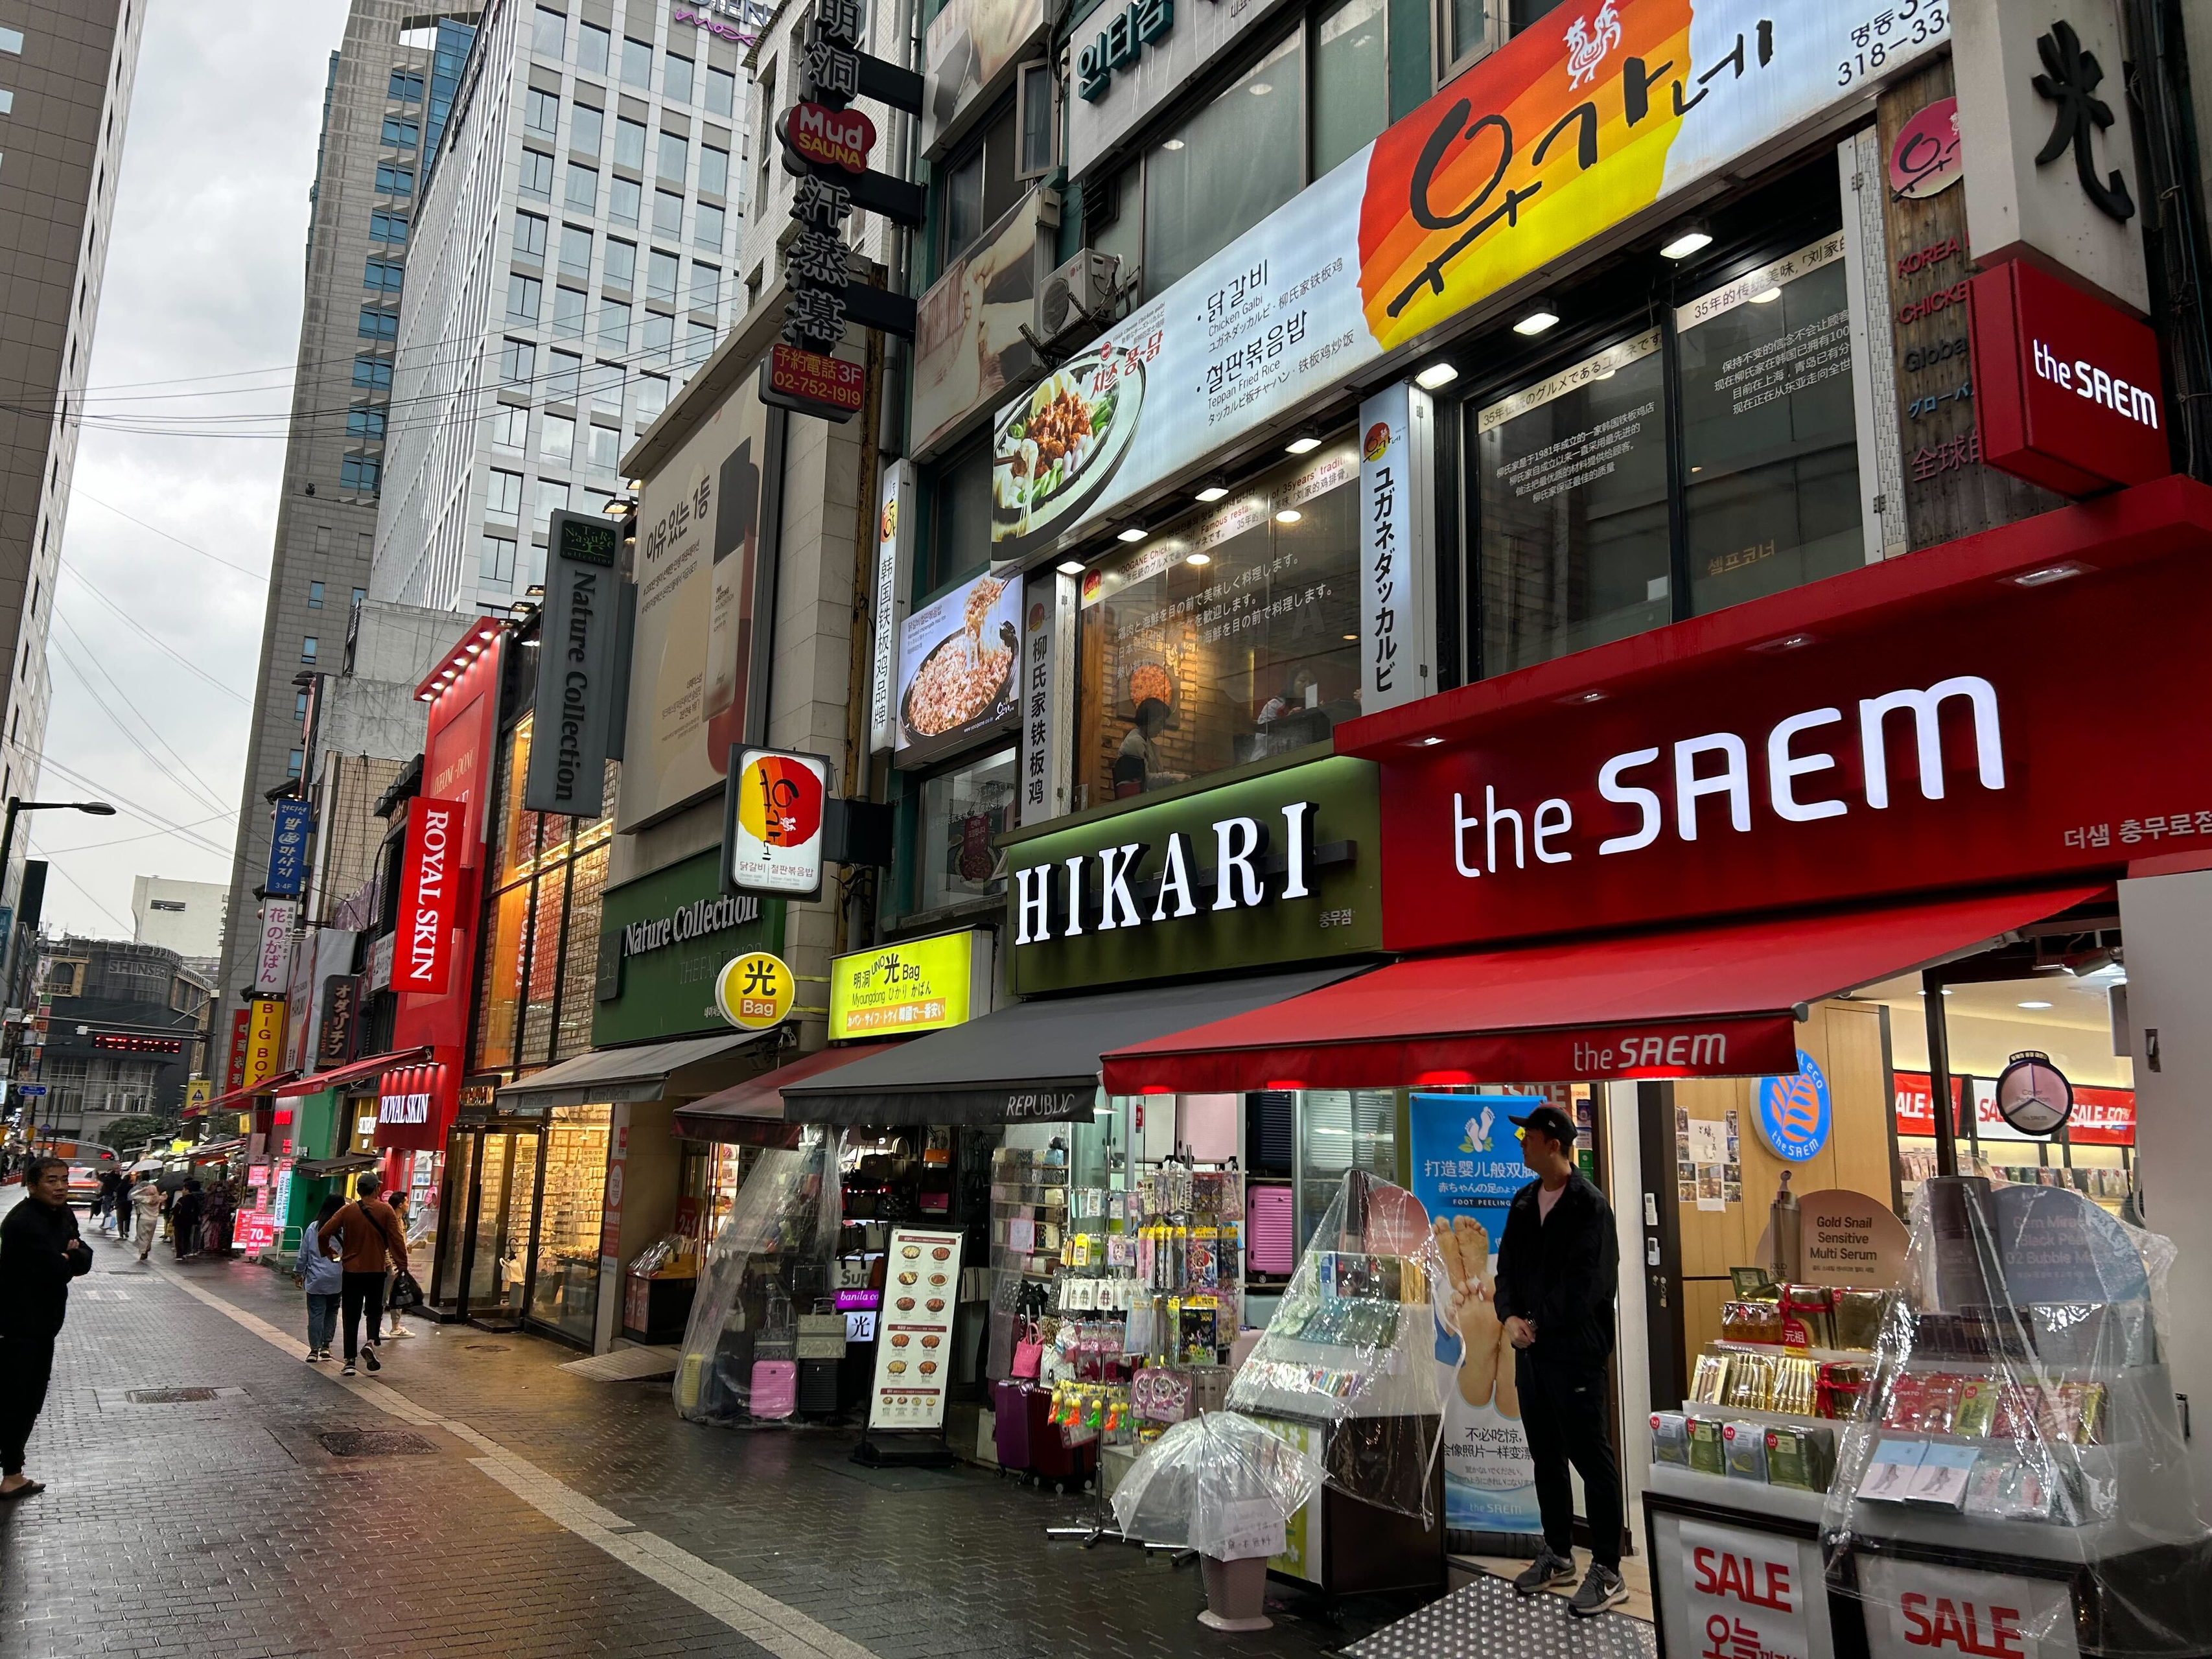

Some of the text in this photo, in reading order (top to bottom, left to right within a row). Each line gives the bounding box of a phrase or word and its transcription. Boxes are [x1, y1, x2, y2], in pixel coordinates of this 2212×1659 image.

[810, 0, 861, 97] 明洞
[1837, 8, 1950, 86] 318-33
[799, 106, 863, 152] Mud
[2032, 20, 2135, 222] 光
[798, 133, 861, 168] SAUNA
[1387, 18, 1773, 318] 유가네
[797, 174, 853, 342] 汗蒸幕
[1897, 237, 1962, 279] KOREA
[1208, 259, 1268, 323] 닭갈비
[1278, 257, 1344, 310] 柳氏家铁板鸡
[1209, 295, 1263, 337] Chicken Galbi
[775, 347, 863, 385] 予約電話 3F
[1205, 310, 1308, 395] 철판볶음밥
[1298, 329, 1354, 373] 铁板鸡炒饭
[774, 371, 861, 406] 02-752-1919
[1090, 360, 1120, 400] 치즈
[1208, 359, 1281, 408] Teppan Fried Rice
[1908, 382, 1973, 419] グローバ
[2032, 338, 2159, 429] the SAEM
[646, 474, 710, 563] 이유 있는 1등
[1117, 554, 1148, 574] YOOGANE
[1201, 516, 1228, 535] Famous
[1272, 489, 1280, 500] of
[1373, 467, 1397, 692] ユガネダッカルビ
[873, 555, 894, 730] 韩国铁板鸡品牌
[555, 569, 596, 802] Nature Collection
[1028, 638, 1047, 806] 柳氏家铁板鸡
[1454, 675, 2005, 878] the SAEM
[281, 804, 308, 815] 컨디션
[2064, 811, 2212, 849] 더샘 충무로점
[740, 861, 813, 877] 닭갈비 철판볶음밥
[1014, 801, 1310, 946] HIKARI
[410, 809, 448, 982] ROYAL SKIN
[624, 895, 758, 957] Nature Collection
[1318, 908, 1353, 928] 충무점
[261, 907, 286, 983] 花のかばん
[742, 960, 776, 996] 光
[853, 953, 920, 990] 明洞 UNO 光 Bag
[743, 999, 774, 1017] Bag
[852, 981, 931, 1007] Myoungdong ひかり かばん
[254, 1003, 274, 1084] BIG BOX
[1574, 1032, 1727, 1072] the SAEM
[1807, 1063, 1824, 1089] eco
[379, 1095, 407, 1124] ROYAL
[407, 1093, 430, 1123] SKIN
[1006, 1093, 1075, 1117] REPUBLIC
[2069, 1104, 2103, 1129] SALE
[1771, 1130, 1820, 1158] the SAEM
[250, 1228, 264, 1240] 70
[1817, 1216, 1872, 1229] Gold Snail
[1818, 1232, 1869, 1244] Sensitive
[1810, 1247, 1877, 1261] Multi Serum
[841, 1290, 868, 1302] banila
[850, 1315, 870, 1339] 光
[1785, 1330, 1806, 1344] 元祖
[1465, 1428, 1522, 1444] 不必吃惊,
[1469, 1502, 1522, 1515] the SAEM
[1694, 1547, 1793, 1613] SALE
[1901, 1592, 2024, 1659] SALE
